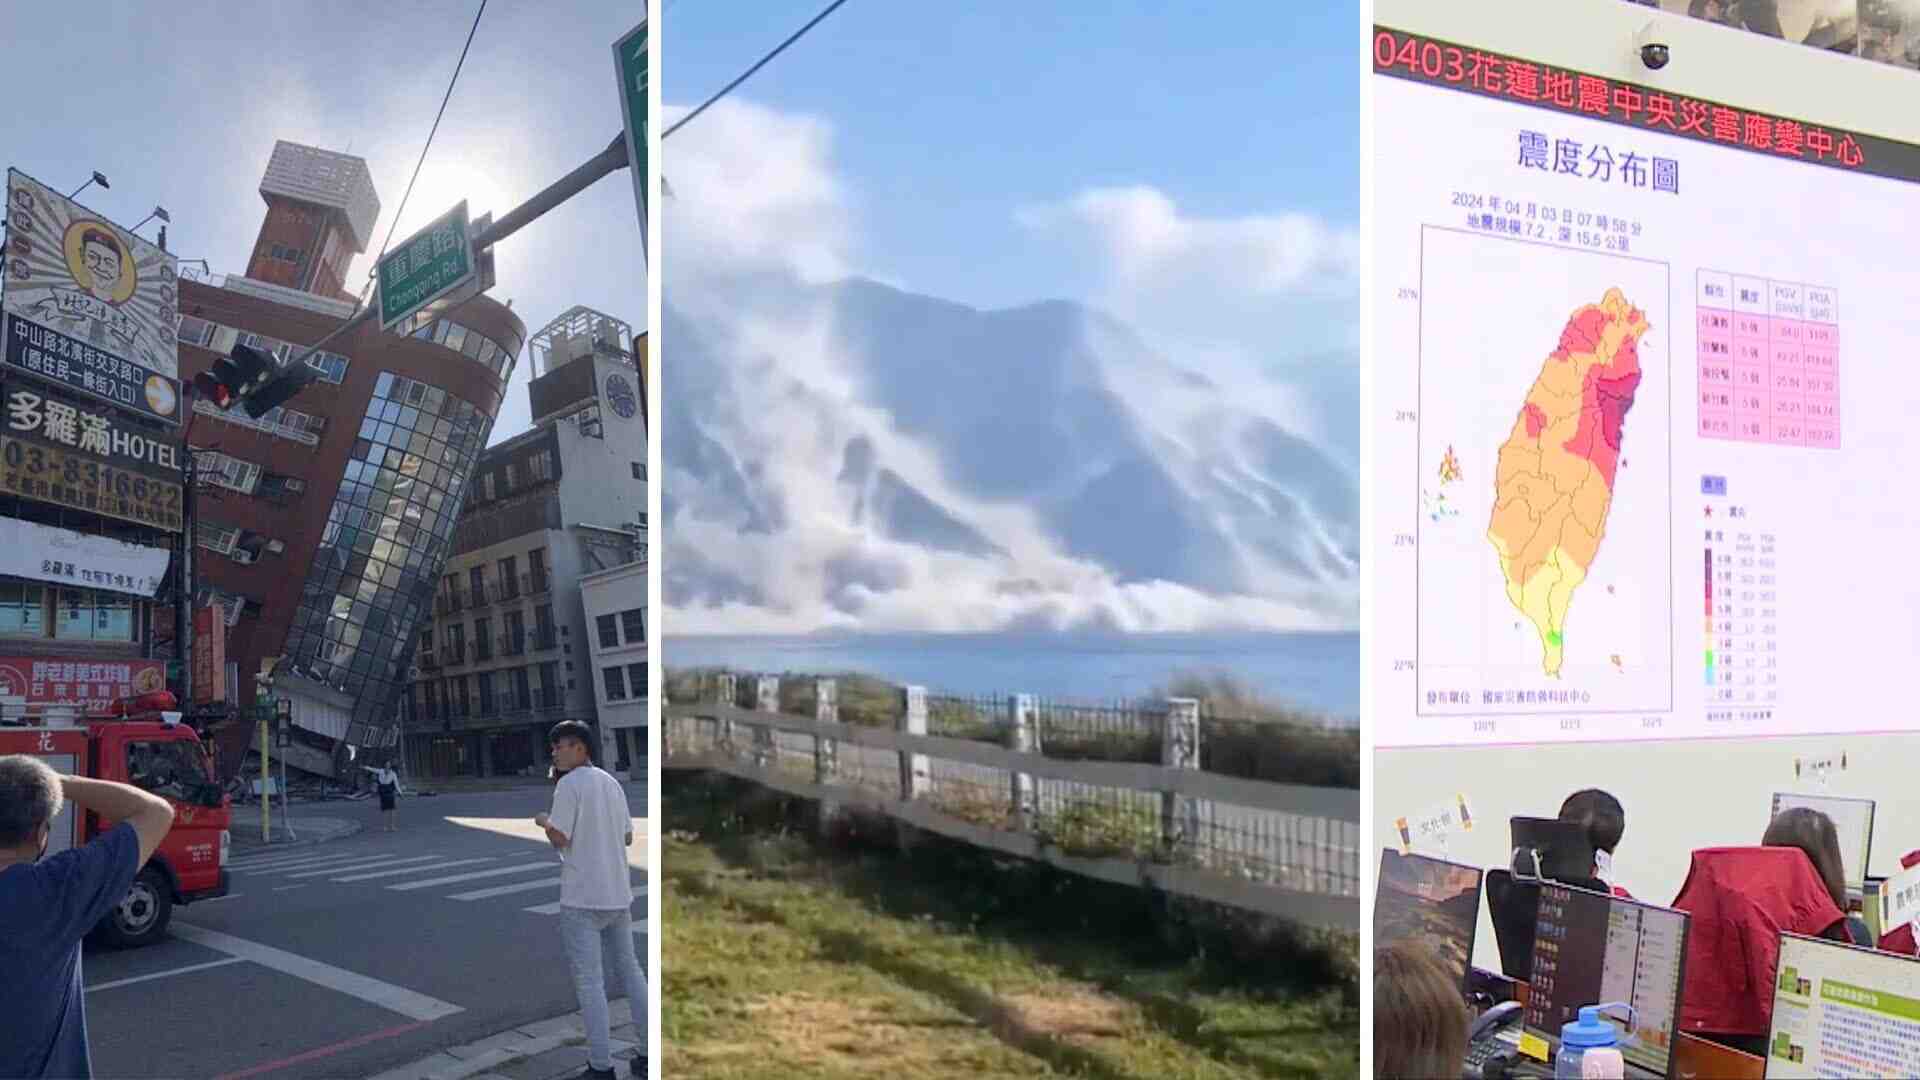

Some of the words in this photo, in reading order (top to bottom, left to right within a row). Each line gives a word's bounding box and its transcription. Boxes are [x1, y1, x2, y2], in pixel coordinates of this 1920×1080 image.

[1374, 31, 1864, 167] 0403花蓮地震中央災害應變中心
[1517, 129, 1679, 195] 震度分布圖
[1452, 191, 1484, 209] 2024
[1488, 195, 1502, 212] 年
[1504, 200, 1521, 215] 04
[1525, 203, 1538, 219] 月
[1541, 206, 1557, 222] 03
[1562, 209, 1573, 224] 日
[1577, 212, 1593, 227] 07
[1525, 222, 1545, 239] 7.2
[1576, 230, 1602, 247] 15.5
[389, 227, 463, 288] 重慶路
[389, 269, 441, 312] Chongqing
[15, 319, 144, 385] 中山路北濱街交叉路口
[7, 391, 182, 471] 多羅滿HOTEL
[5, 440, 179, 507] 03-8316622
[39, 731, 55, 752] 花
